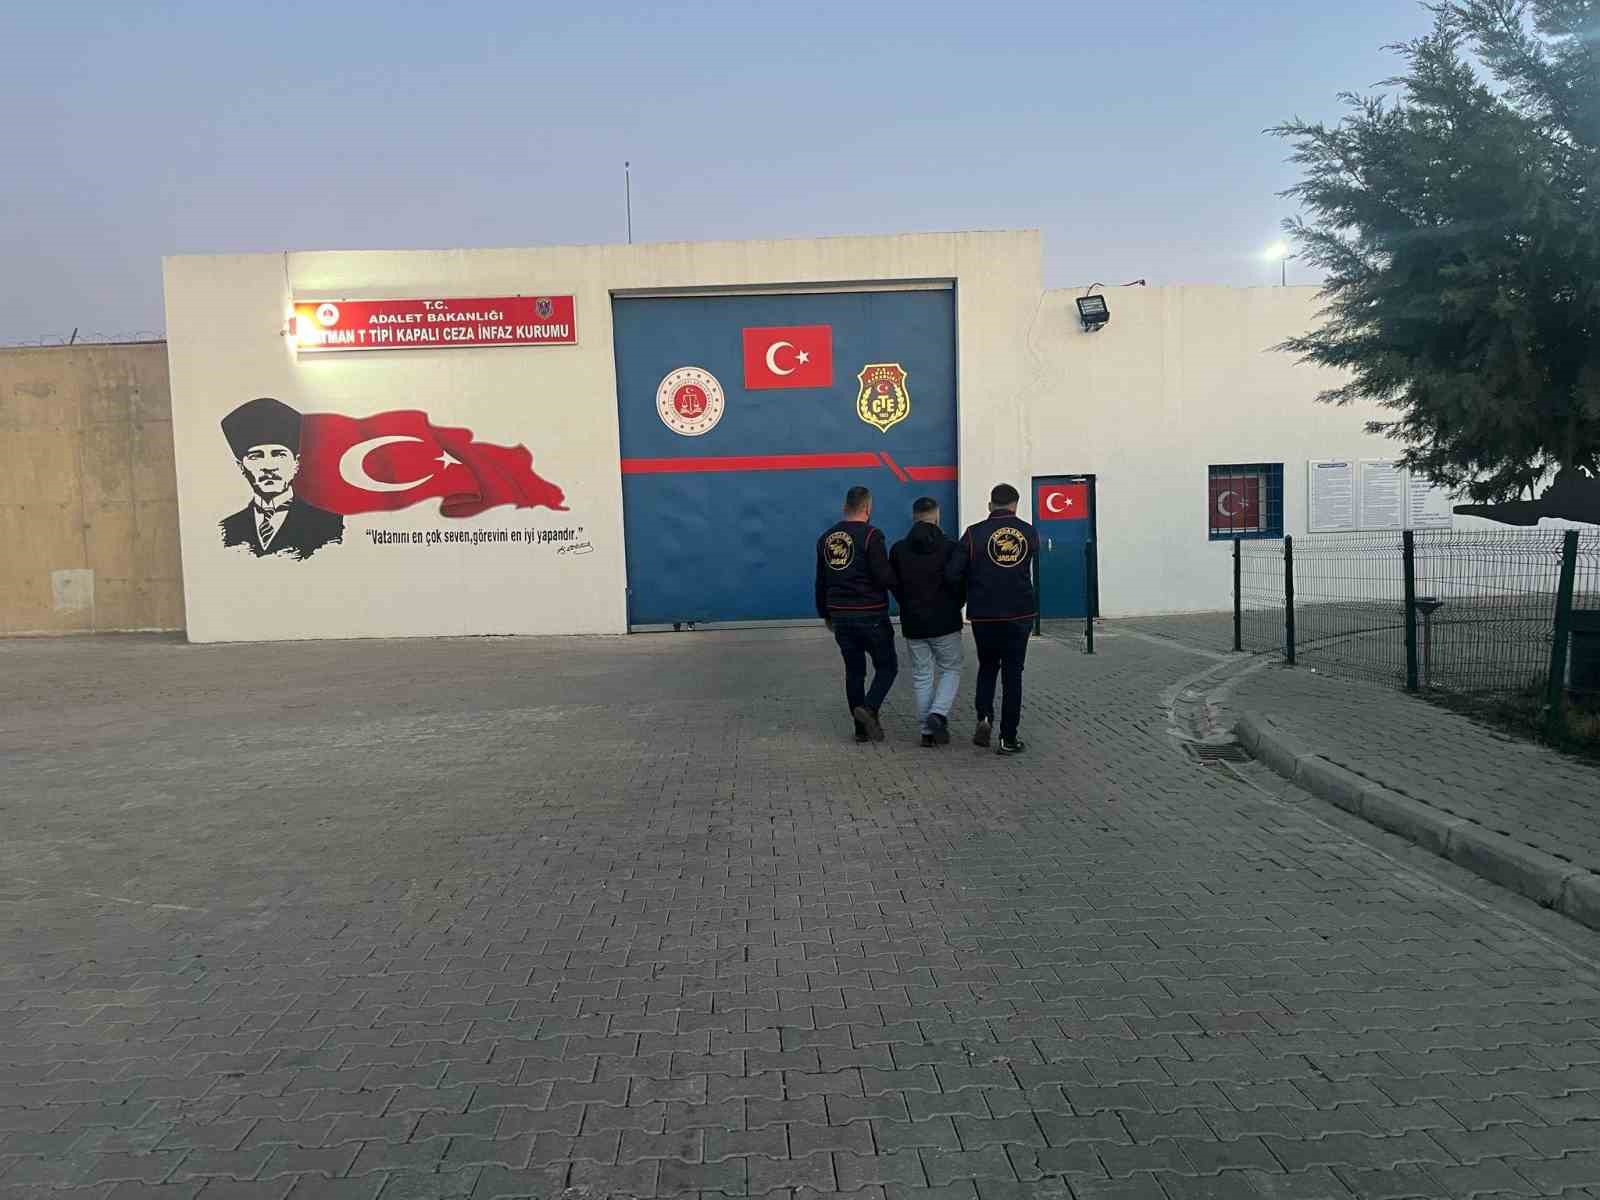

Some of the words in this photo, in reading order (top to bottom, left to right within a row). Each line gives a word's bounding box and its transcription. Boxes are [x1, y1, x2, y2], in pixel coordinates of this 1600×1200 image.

[423, 301, 449, 310] T.C.
[369, 314, 423, 324] ADALET
[427, 311, 504, 322] BAKANLIĞI
[358, 329, 366, 343] T
[369, 326, 393, 343] TİPİ
[397, 327, 439, 342] KAPALI
[443, 327, 474, 341] CEZA
[478, 324, 512, 340] İNFAZ
[516, 324, 569, 338] KURUMU
[412, 531, 423, 544] en
[425, 529, 442, 547] çok
[511, 530, 522, 542] en
[524, 528, 535, 545] iyi
